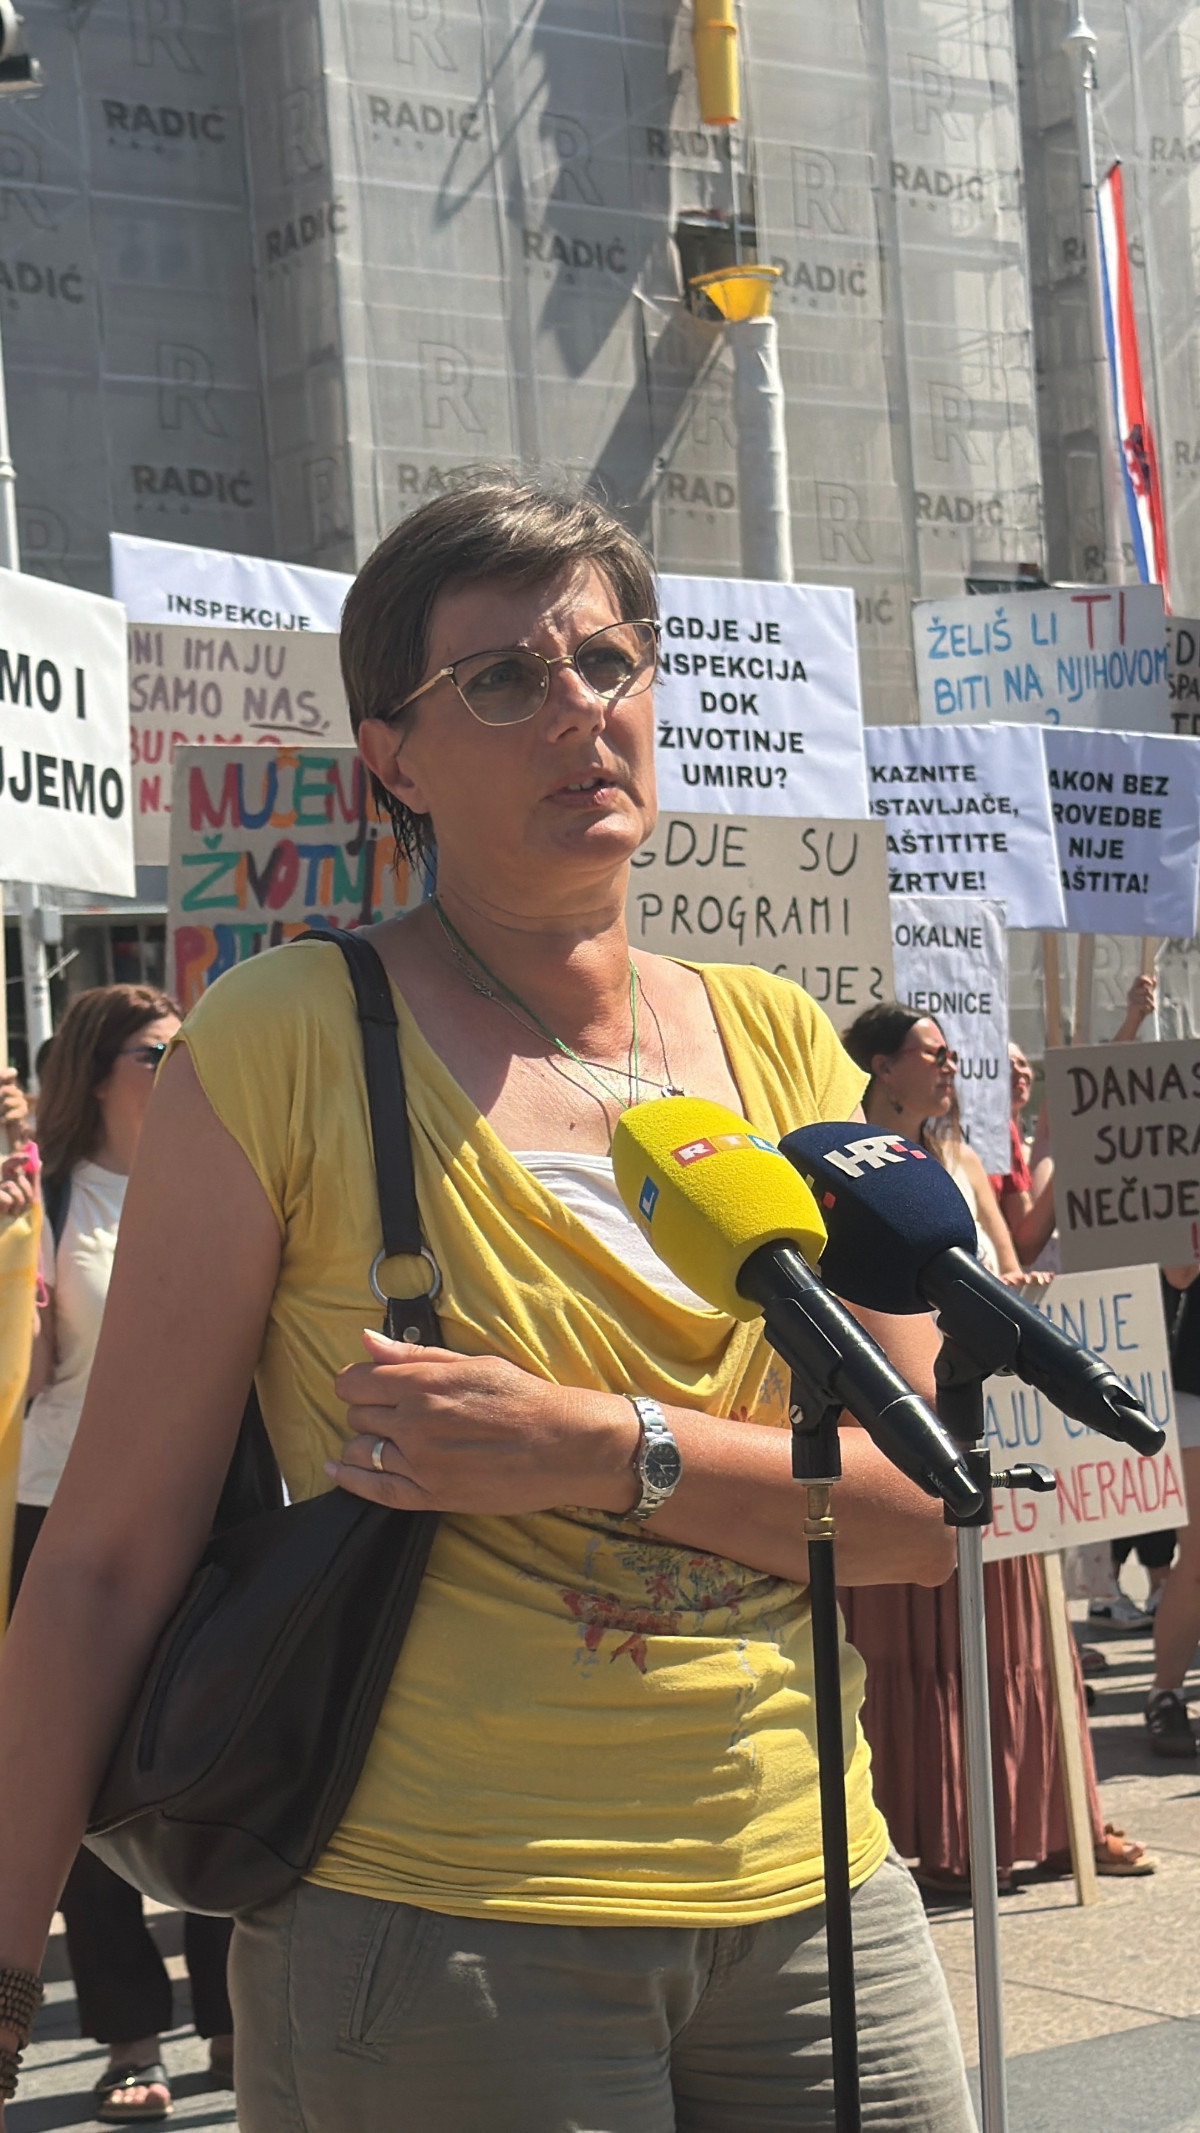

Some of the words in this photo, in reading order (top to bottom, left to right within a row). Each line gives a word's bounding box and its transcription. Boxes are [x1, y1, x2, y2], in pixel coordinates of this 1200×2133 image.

[103, 100, 226, 143] RADIĆ
[368, 94, 482, 142] RADIĆ
[521, 229, 629, 274] RADIĆ
[130, 464, 256, 508] RADIĆ
[666, 472, 736, 509] RAD
[166, 594, 311, 631] INSPEKCIJE
[666, 616, 739, 642] GDJE
[749, 622, 781, 644] JE
[927, 606, 1012, 660] ŽELIŠ
[1031, 612, 1057, 646] LI
[1070, 590, 1125, 651] TI
[184, 637, 287, 680] IMAJU
[658, 652, 808, 683] NSPEKCIJA
[75, 666, 87, 720] I
[130, 672, 223, 720] SAMO
[934, 674, 991, 716] BITI
[1003, 663, 1044, 703] NA
[1056, 646, 1168, 703] NJIHOVOM
[701, 691, 760, 716] DOK
[657, 719, 805, 755] ŽIVOTINJE
[0, 744, 124, 821] JEMO
[682, 763, 788, 789] UMIRU?
[870, 764, 977, 784] KAZNITE
[1048, 768, 1114, 793] AKON
[1122, 772, 1170, 796] BEZ
[869, 792, 1019, 818] STAVLJAČE,
[1052, 802, 1162, 829] ROVEDBE
[799, 827, 859, 877] SU
[886, 828, 1009, 855] AŠTITITE
[1068, 836, 1125, 861] NIJE
[887, 866, 986, 893] ŽRTVE!
[1060, 864, 1150, 895] AŠTITA!
[636, 893, 851, 947] PROGRAMI
[894, 924, 983, 950] OKALNE
[960, 1058, 999, 1081] UJU
[1066, 1176, 1200, 1231] NEČIJE
[1055, 1453, 1183, 1524] NERADA
